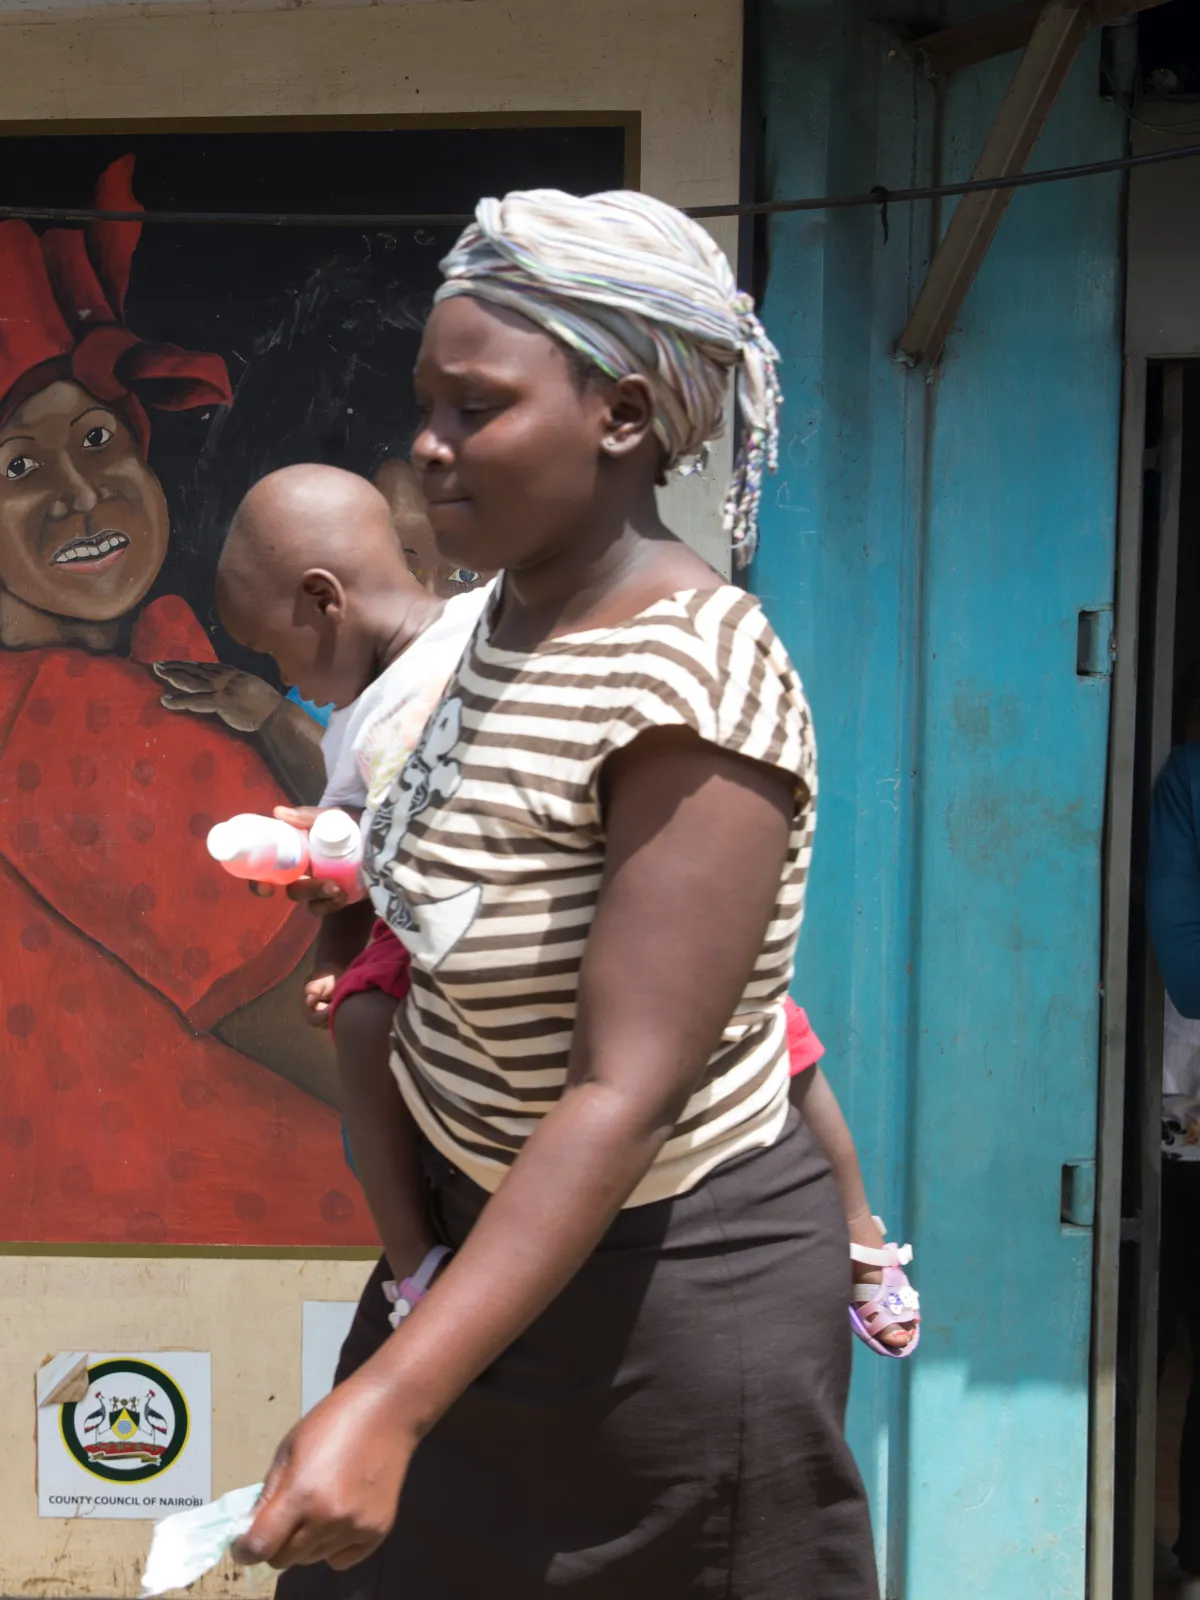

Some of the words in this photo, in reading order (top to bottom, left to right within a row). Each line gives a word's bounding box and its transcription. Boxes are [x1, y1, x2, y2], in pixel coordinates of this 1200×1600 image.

[48, 1495, 94, 1505] COUNTY
[94, 1496, 141, 1506] COUNCIL
[143, 1497, 157, 1506] OF
[159, 1497, 203, 1507] NAIROBI
